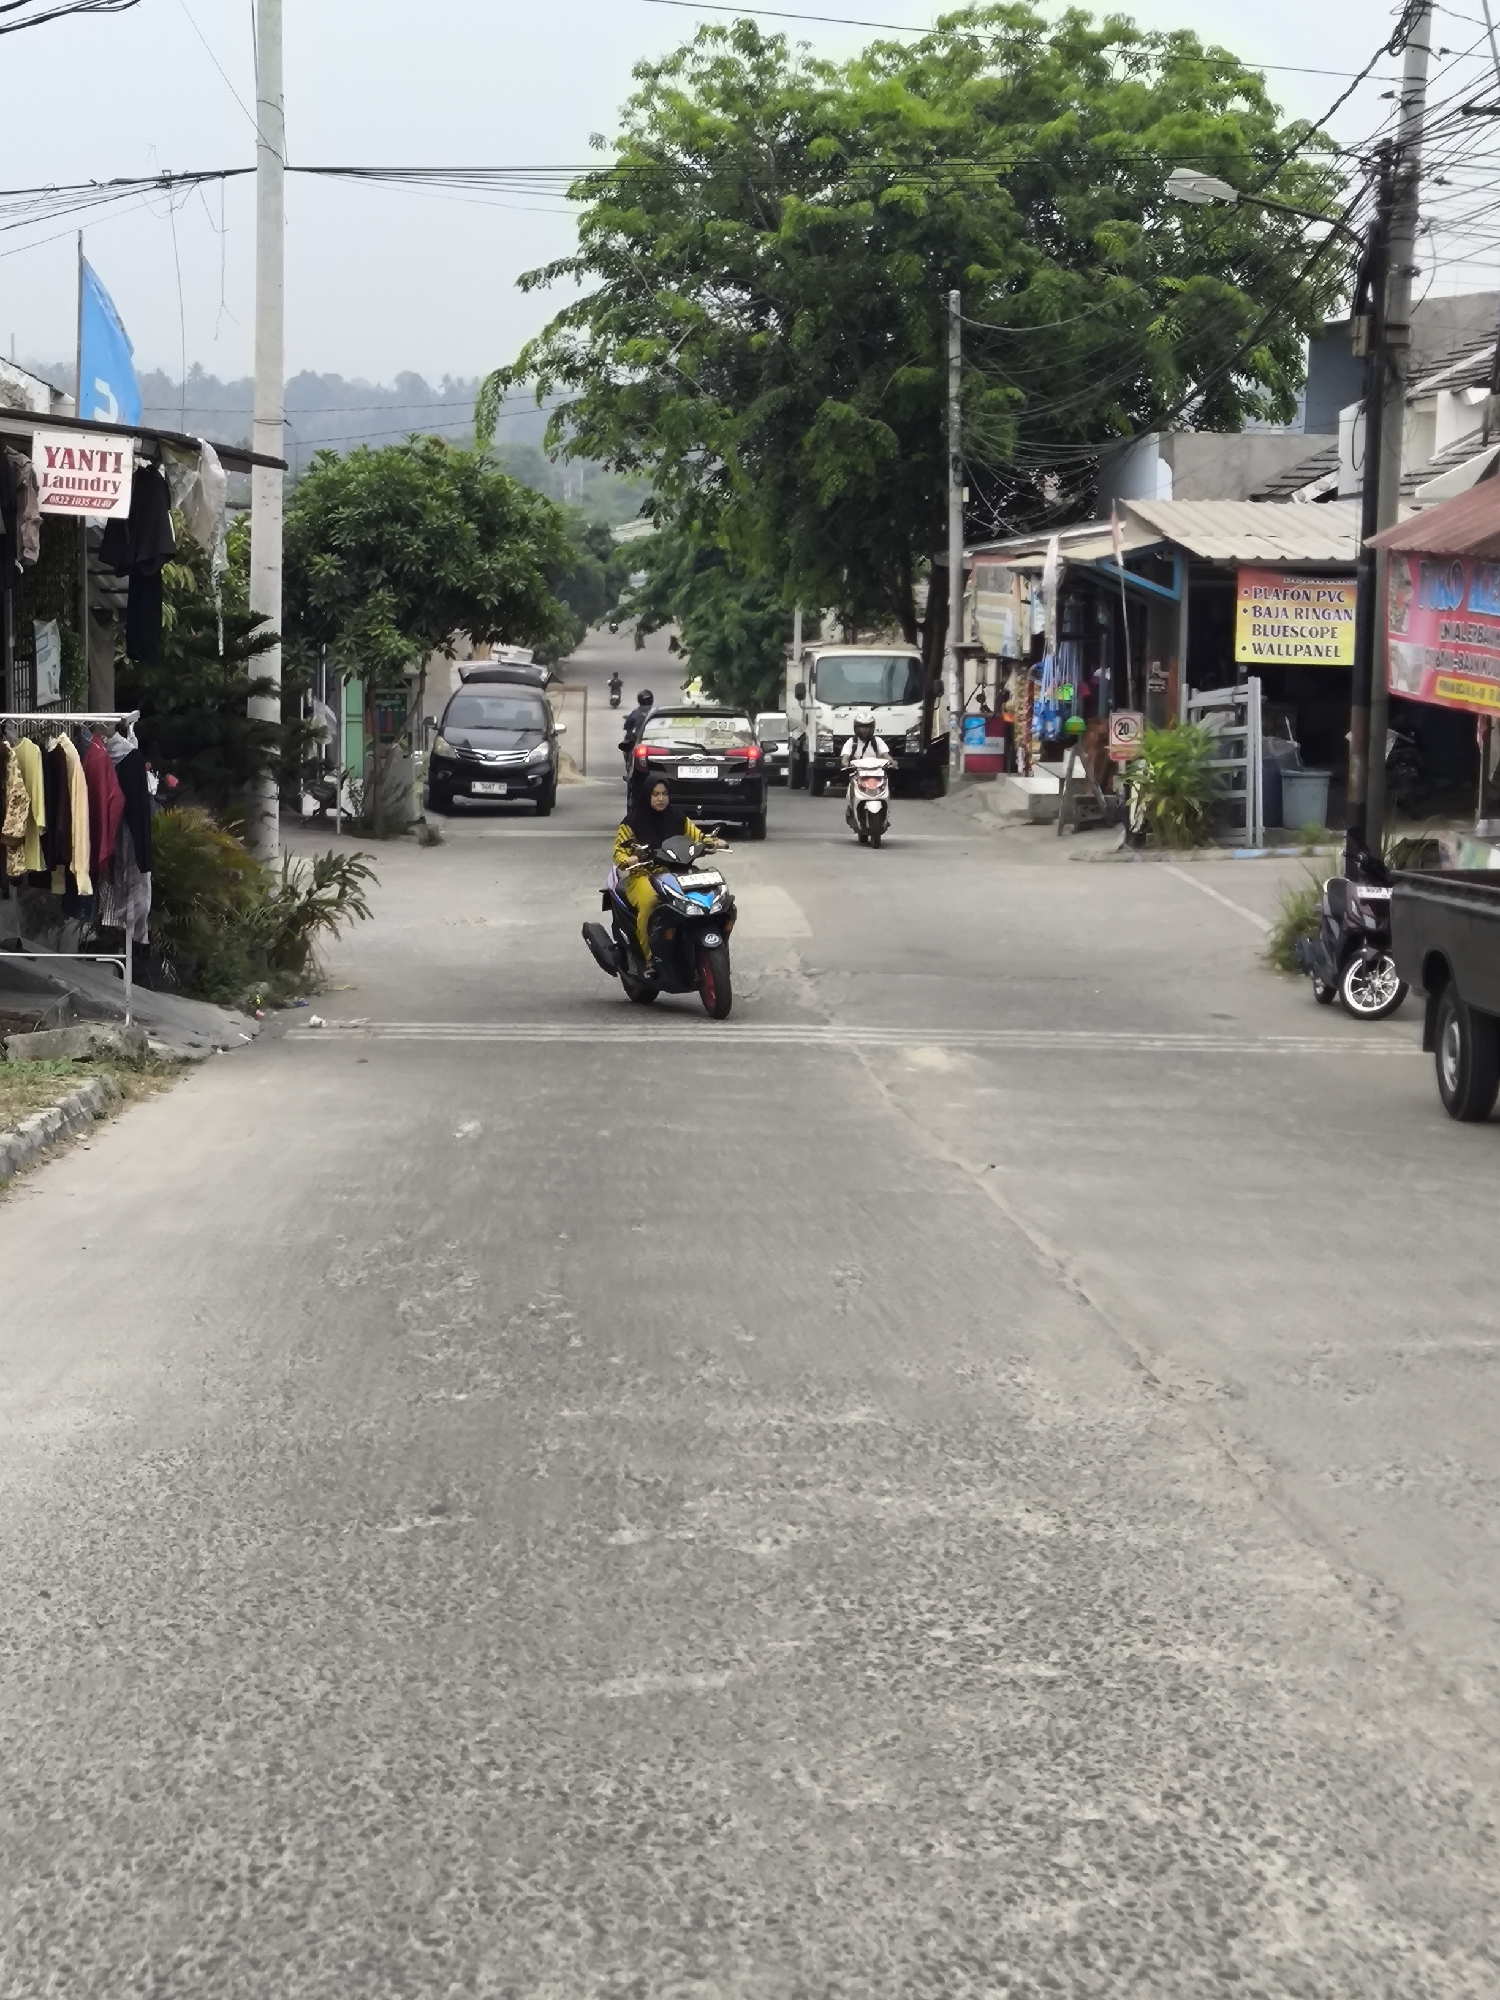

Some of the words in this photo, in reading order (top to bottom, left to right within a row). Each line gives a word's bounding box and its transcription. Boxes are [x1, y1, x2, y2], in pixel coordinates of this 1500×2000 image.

[43, 445, 124, 474] YANTI
[41, 472, 122, 495] Laundry
[1252, 586, 1312, 602] PLAFON
[1316, 589, 1347, 603] PVC
[1252, 604, 1290, 619] BAJA
[1294, 606, 1354, 621] RINGAN
[1251, 623, 1339, 639] BLUESCOPE
[1251, 641, 1342, 658] WALLPANEL
[1118, 722, 1130, 735] 20
